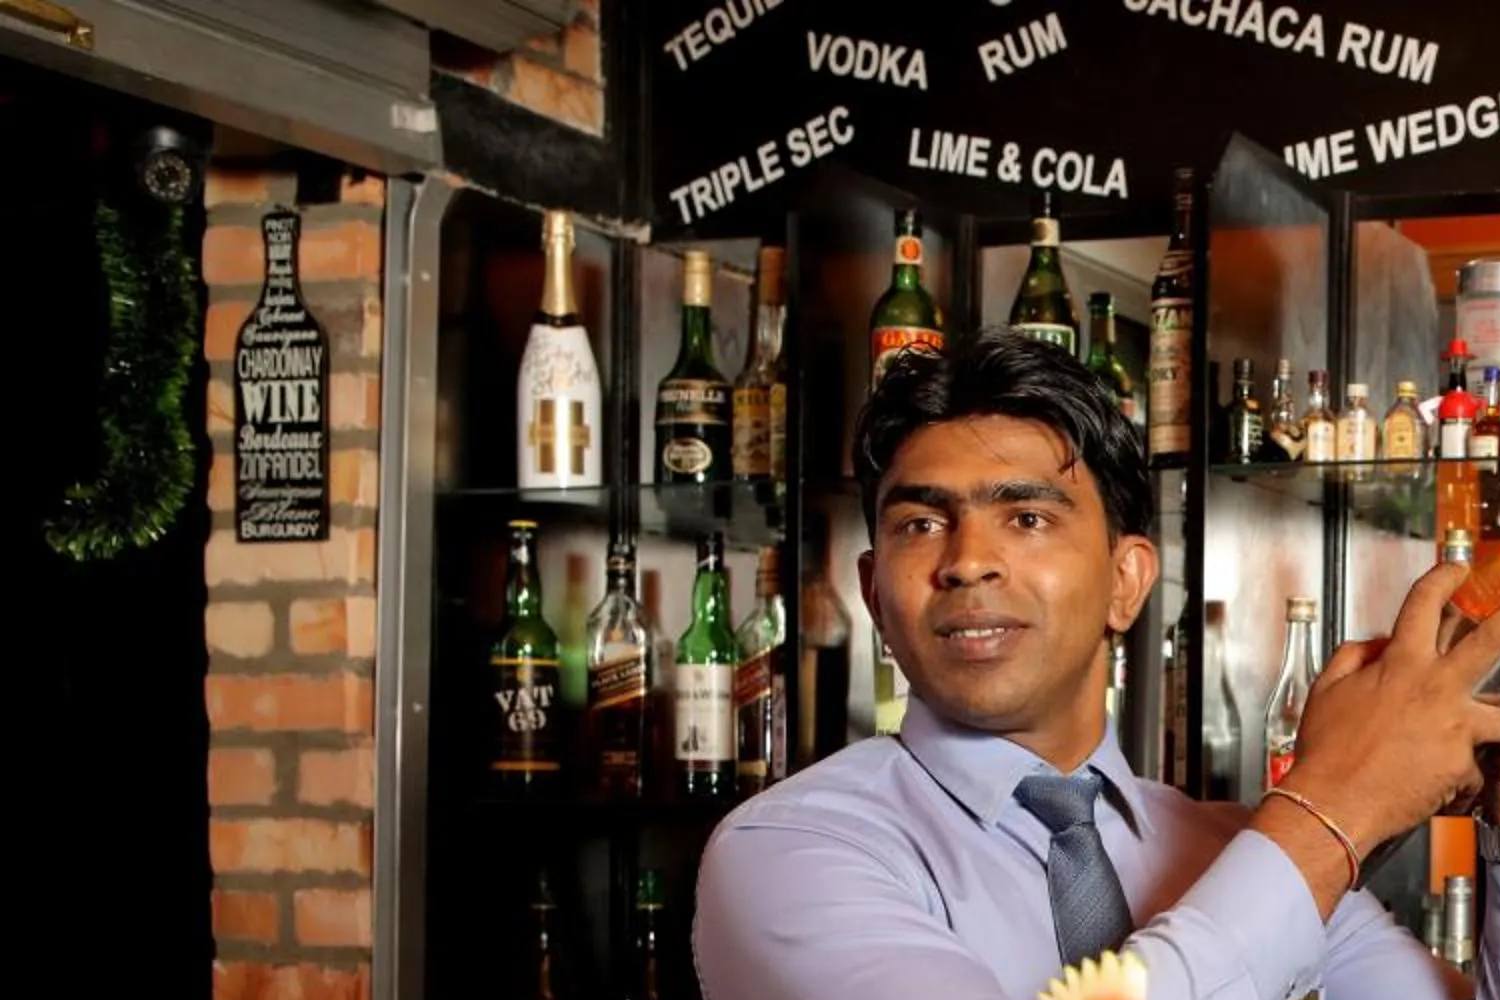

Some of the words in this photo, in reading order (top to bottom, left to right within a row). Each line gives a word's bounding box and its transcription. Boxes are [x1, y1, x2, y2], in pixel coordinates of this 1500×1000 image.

[664, 0, 785, 71] TEQU
[807, 31, 928, 91] VODKA
[978, 13, 1068, 83] RUM
[1337, 21, 1440, 85] RUM
[670, 141, 785, 225] TRIPLE
[786, 105, 856, 168] SEC
[909, 128, 991, 178] LIME
[998, 142, 1022, 184] &
[1032, 147, 1129, 199] COLA
[1285, 129, 1359, 181] IME
[240, 379, 320, 424] WINE
[238, 423, 323, 451] Bordeaux
[240, 452, 323, 483] ZINFANDEL
[494, 683, 554, 714] VAT
[507, 709, 547, 733] 69
